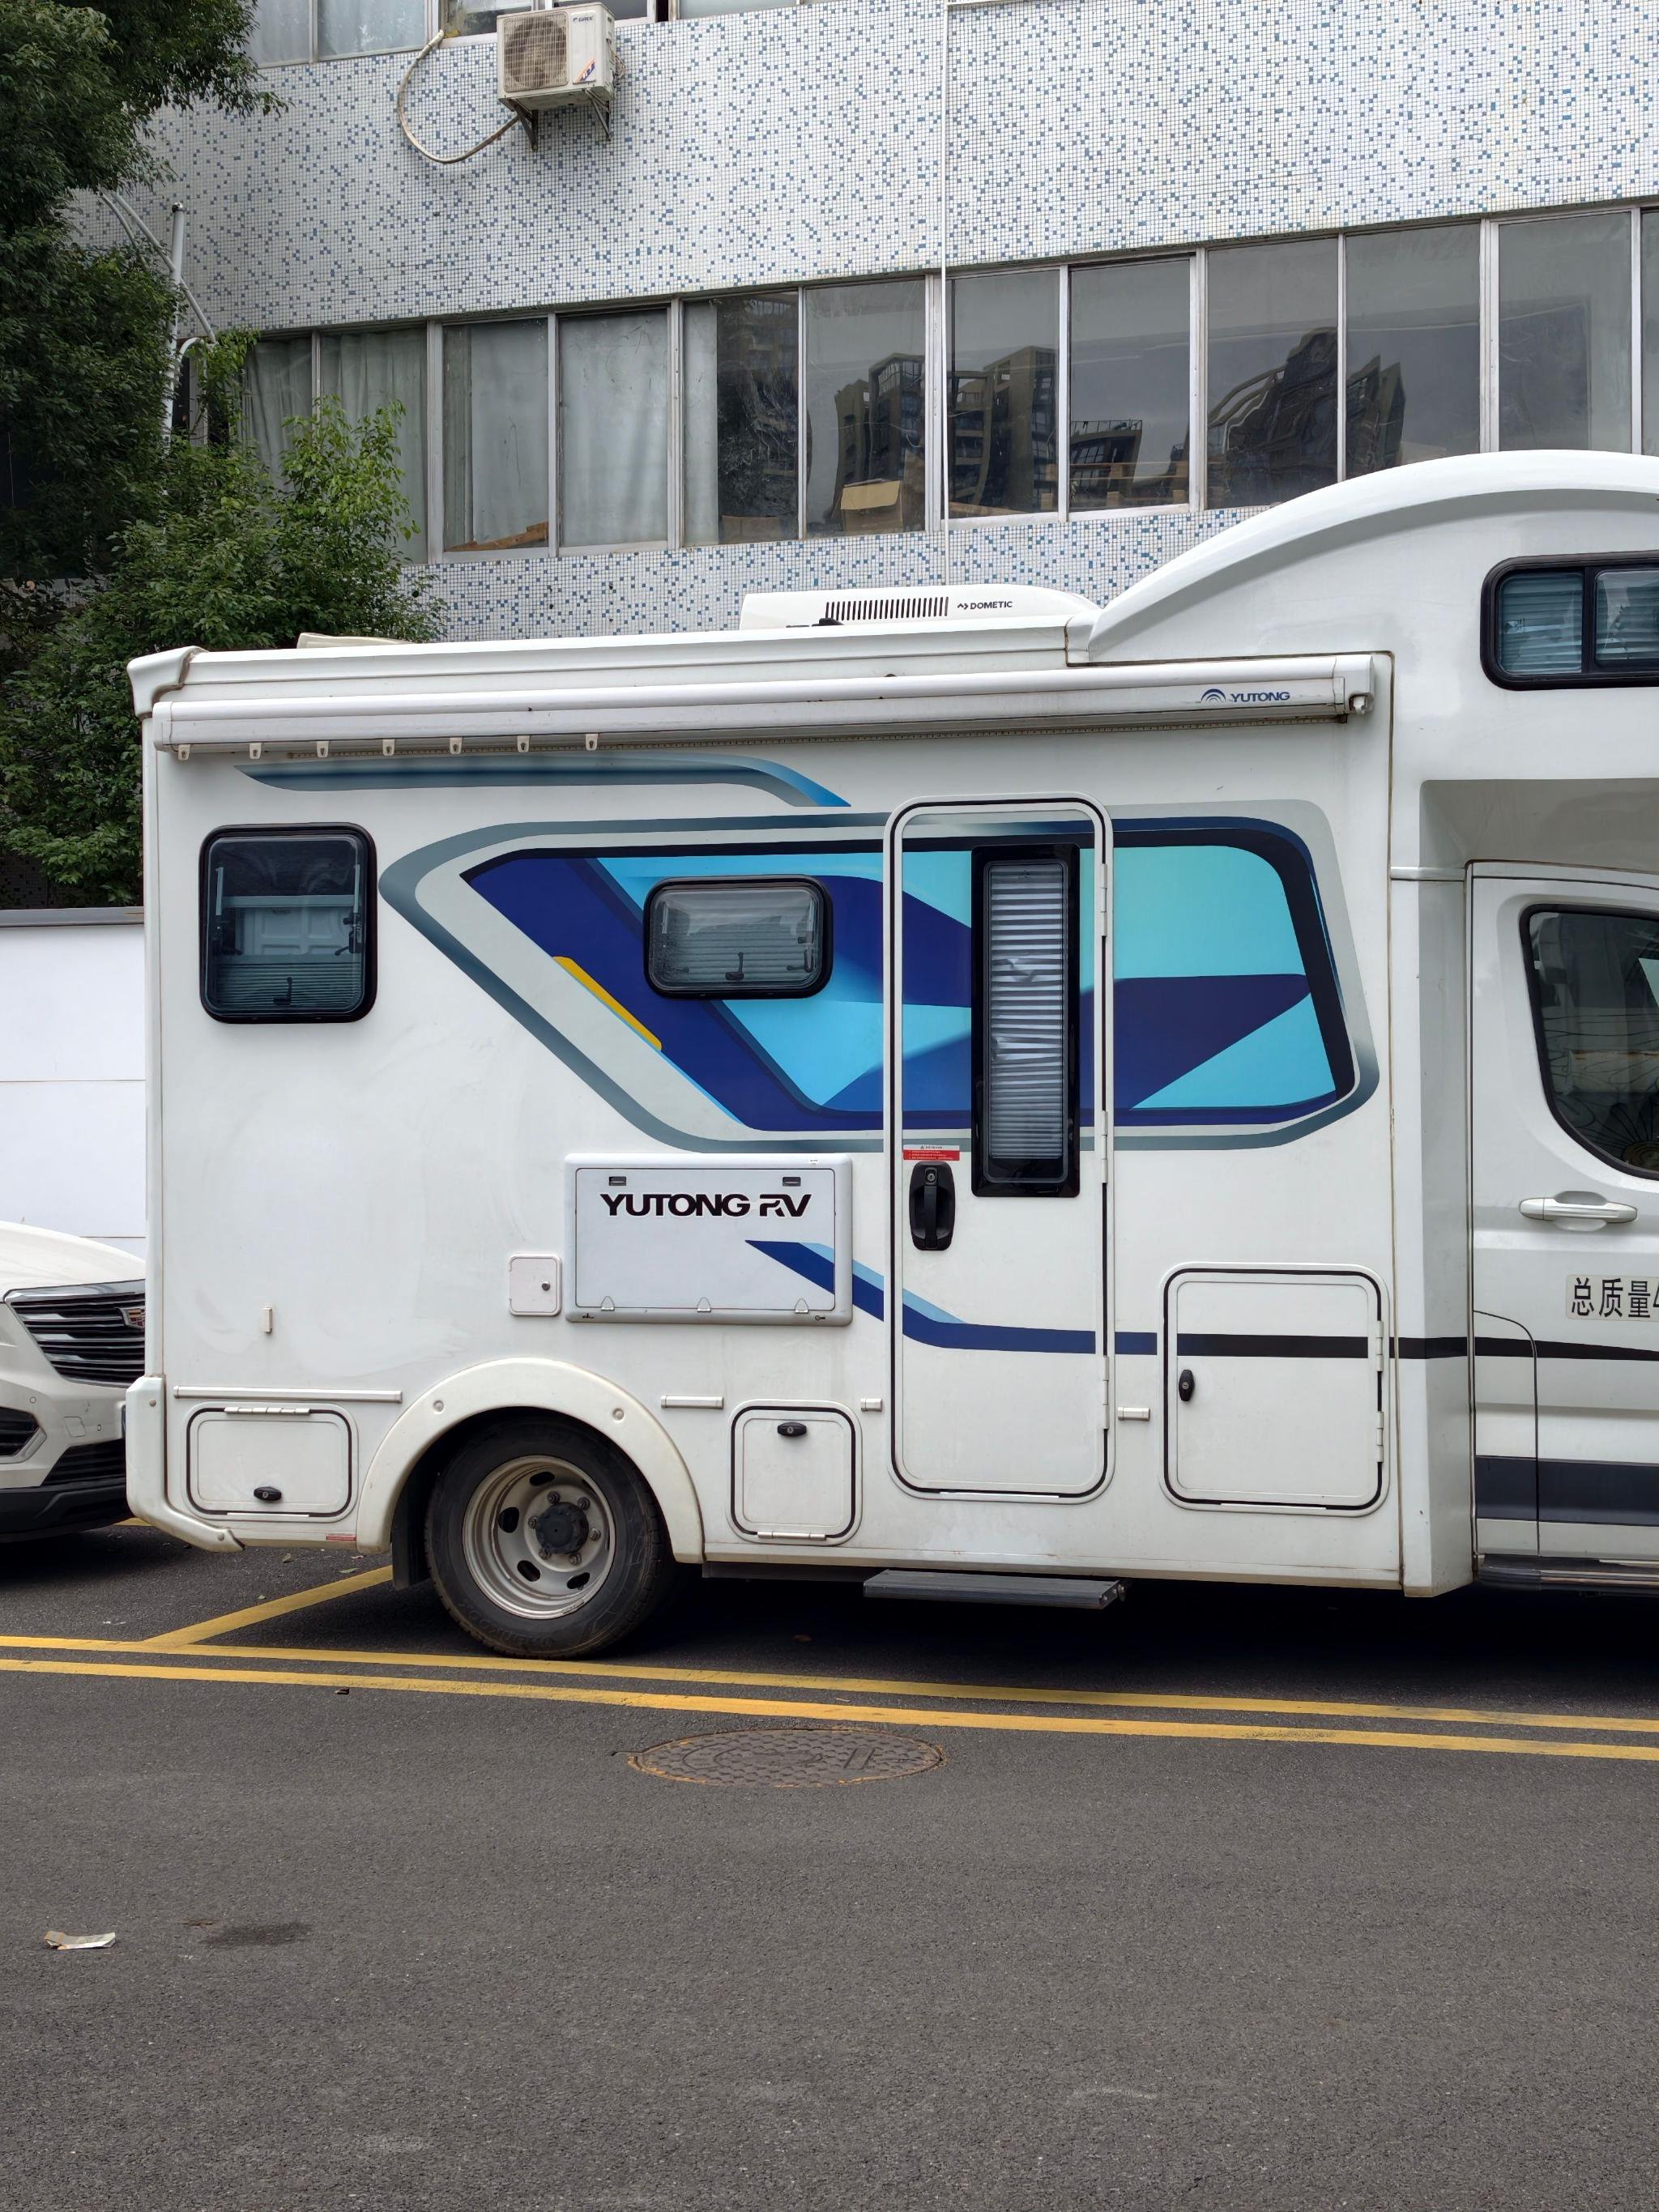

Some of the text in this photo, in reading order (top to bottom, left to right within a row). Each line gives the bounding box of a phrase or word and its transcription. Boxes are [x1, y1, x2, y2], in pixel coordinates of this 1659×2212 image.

[970, 600, 1013, 609] DOMETIC
[1230, 692, 1290, 702] YUTONG
[599, 1193, 812, 1217] YUTONG RV
